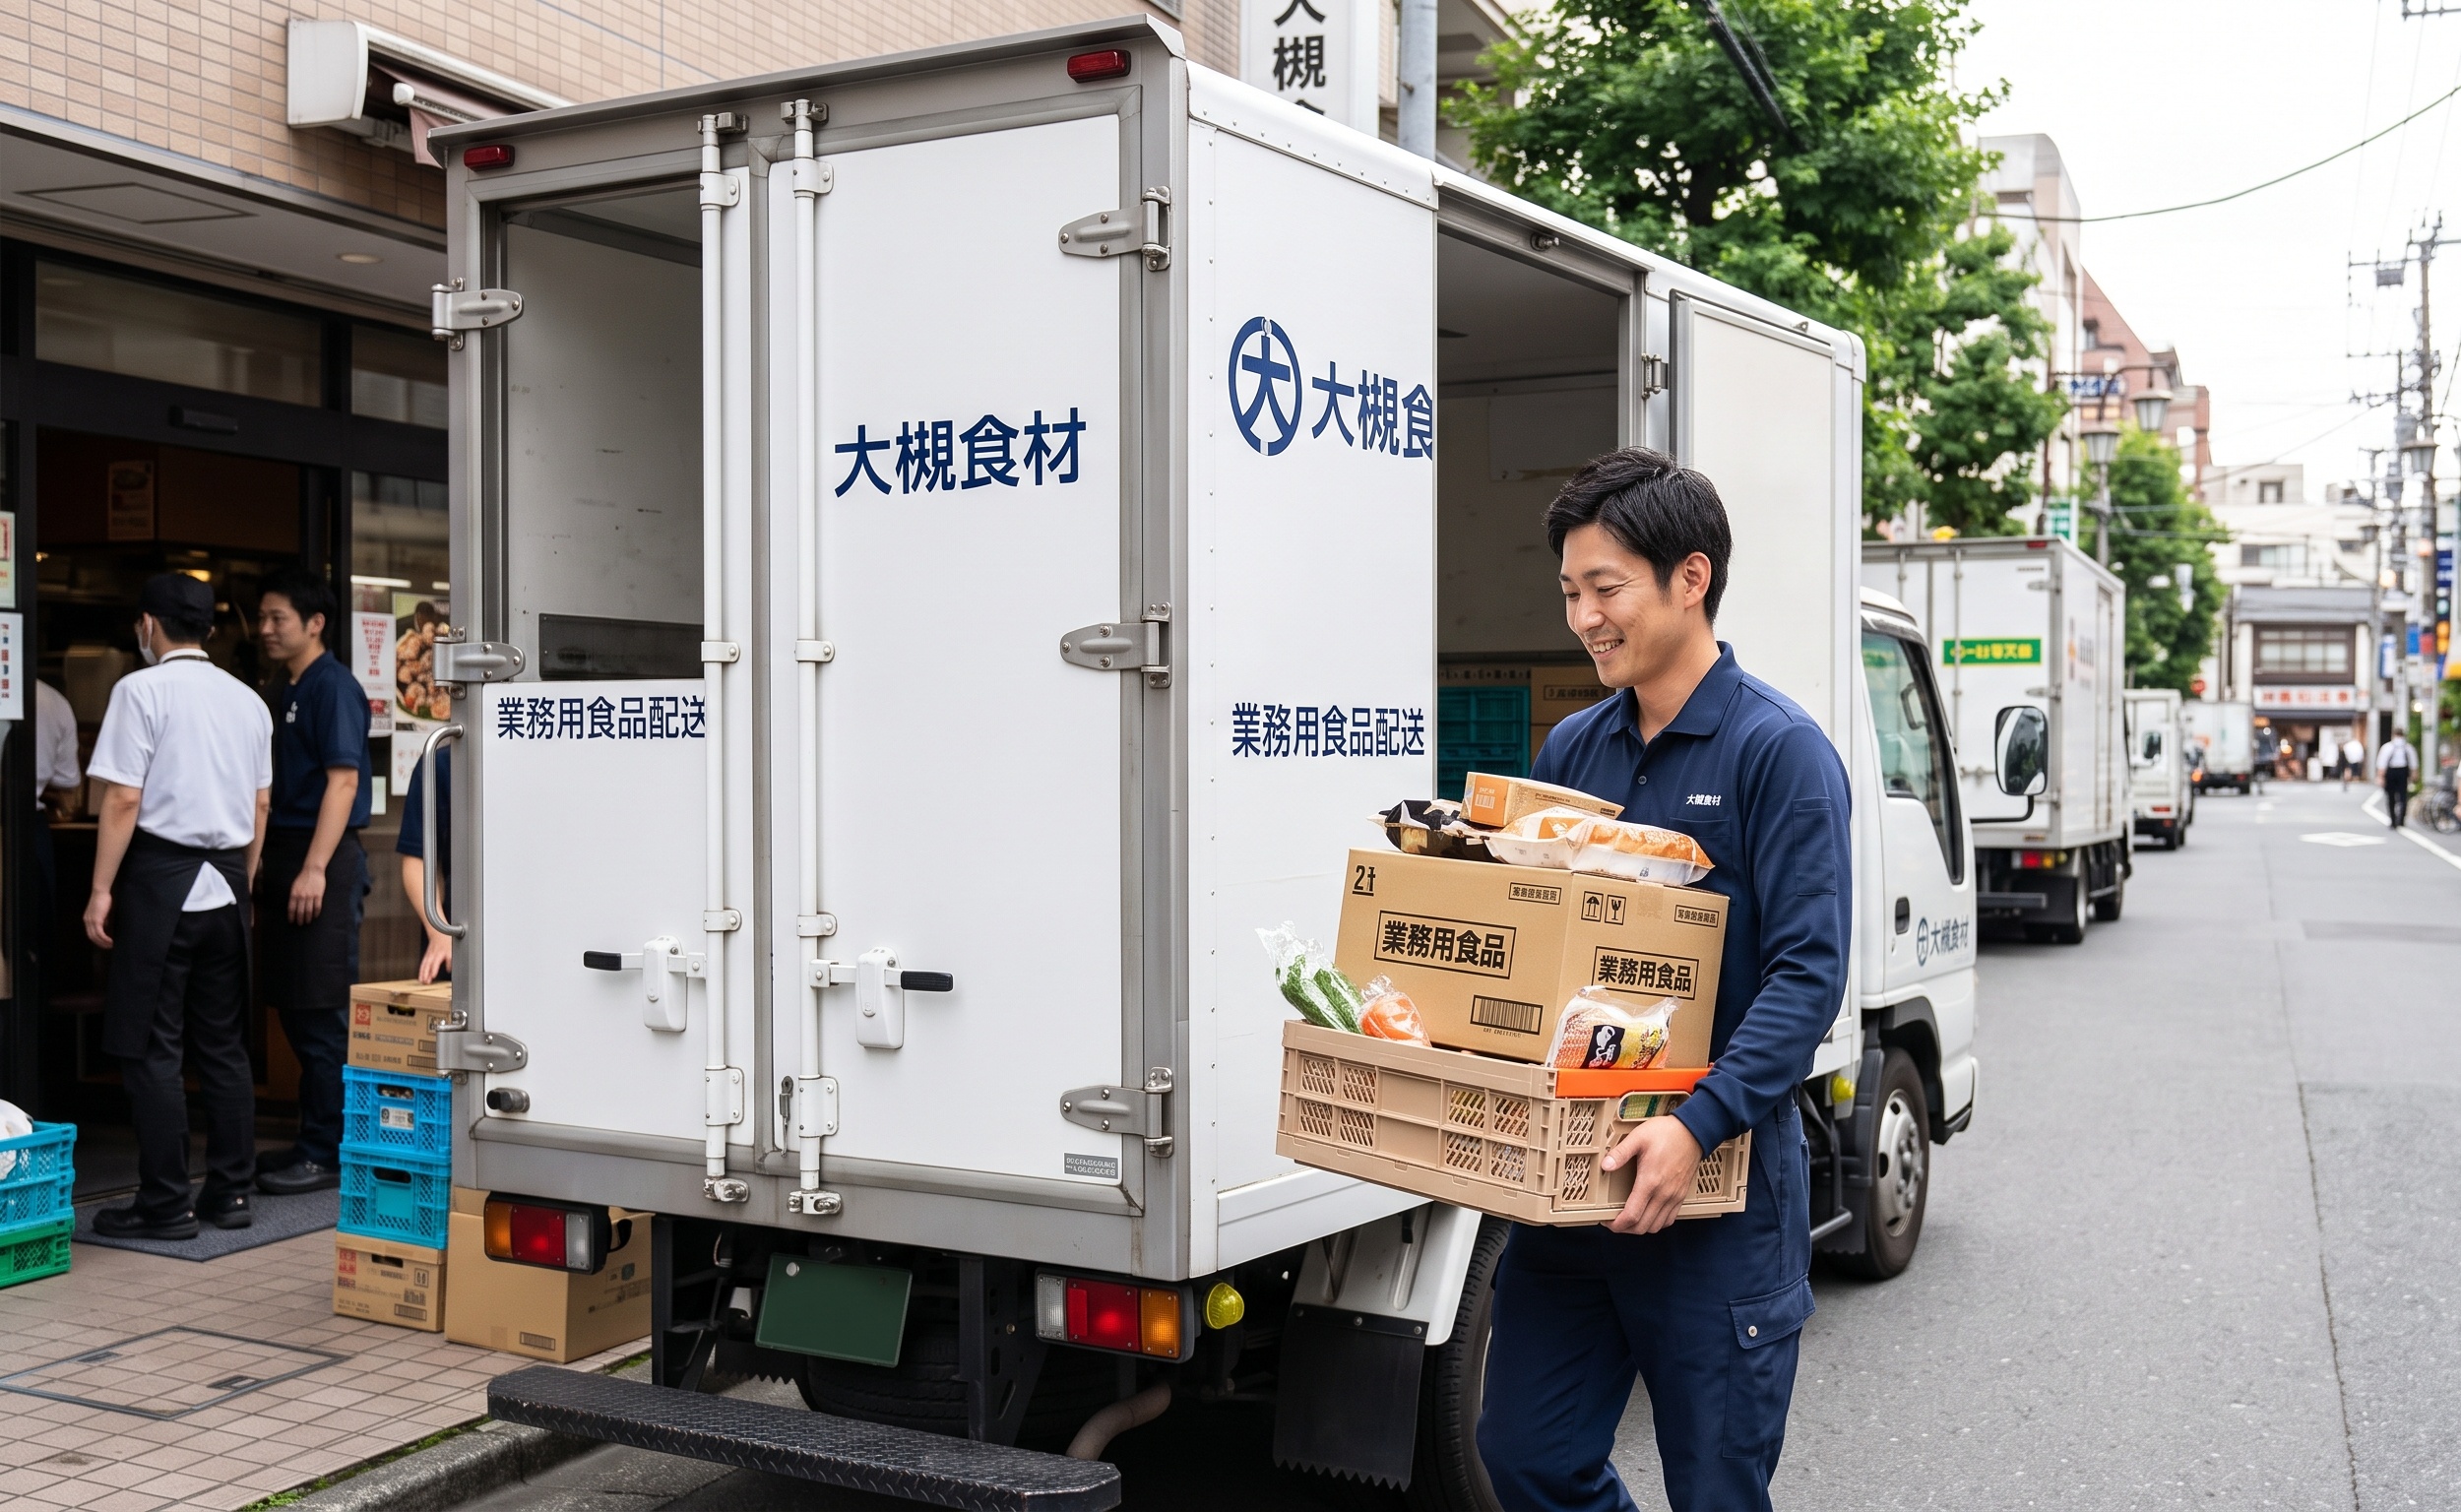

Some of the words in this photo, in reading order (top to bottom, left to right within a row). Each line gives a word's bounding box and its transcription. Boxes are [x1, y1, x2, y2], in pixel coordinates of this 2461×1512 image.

[835, 407, 1087, 498] 大槻食材
[497, 695, 705, 739] 業務用食品配送
[1232, 702, 1424, 757] 業務用食品配送
[1382, 919, 1506, 970] 業務用食品
[1598, 955, 1692, 992] 業務用食品
